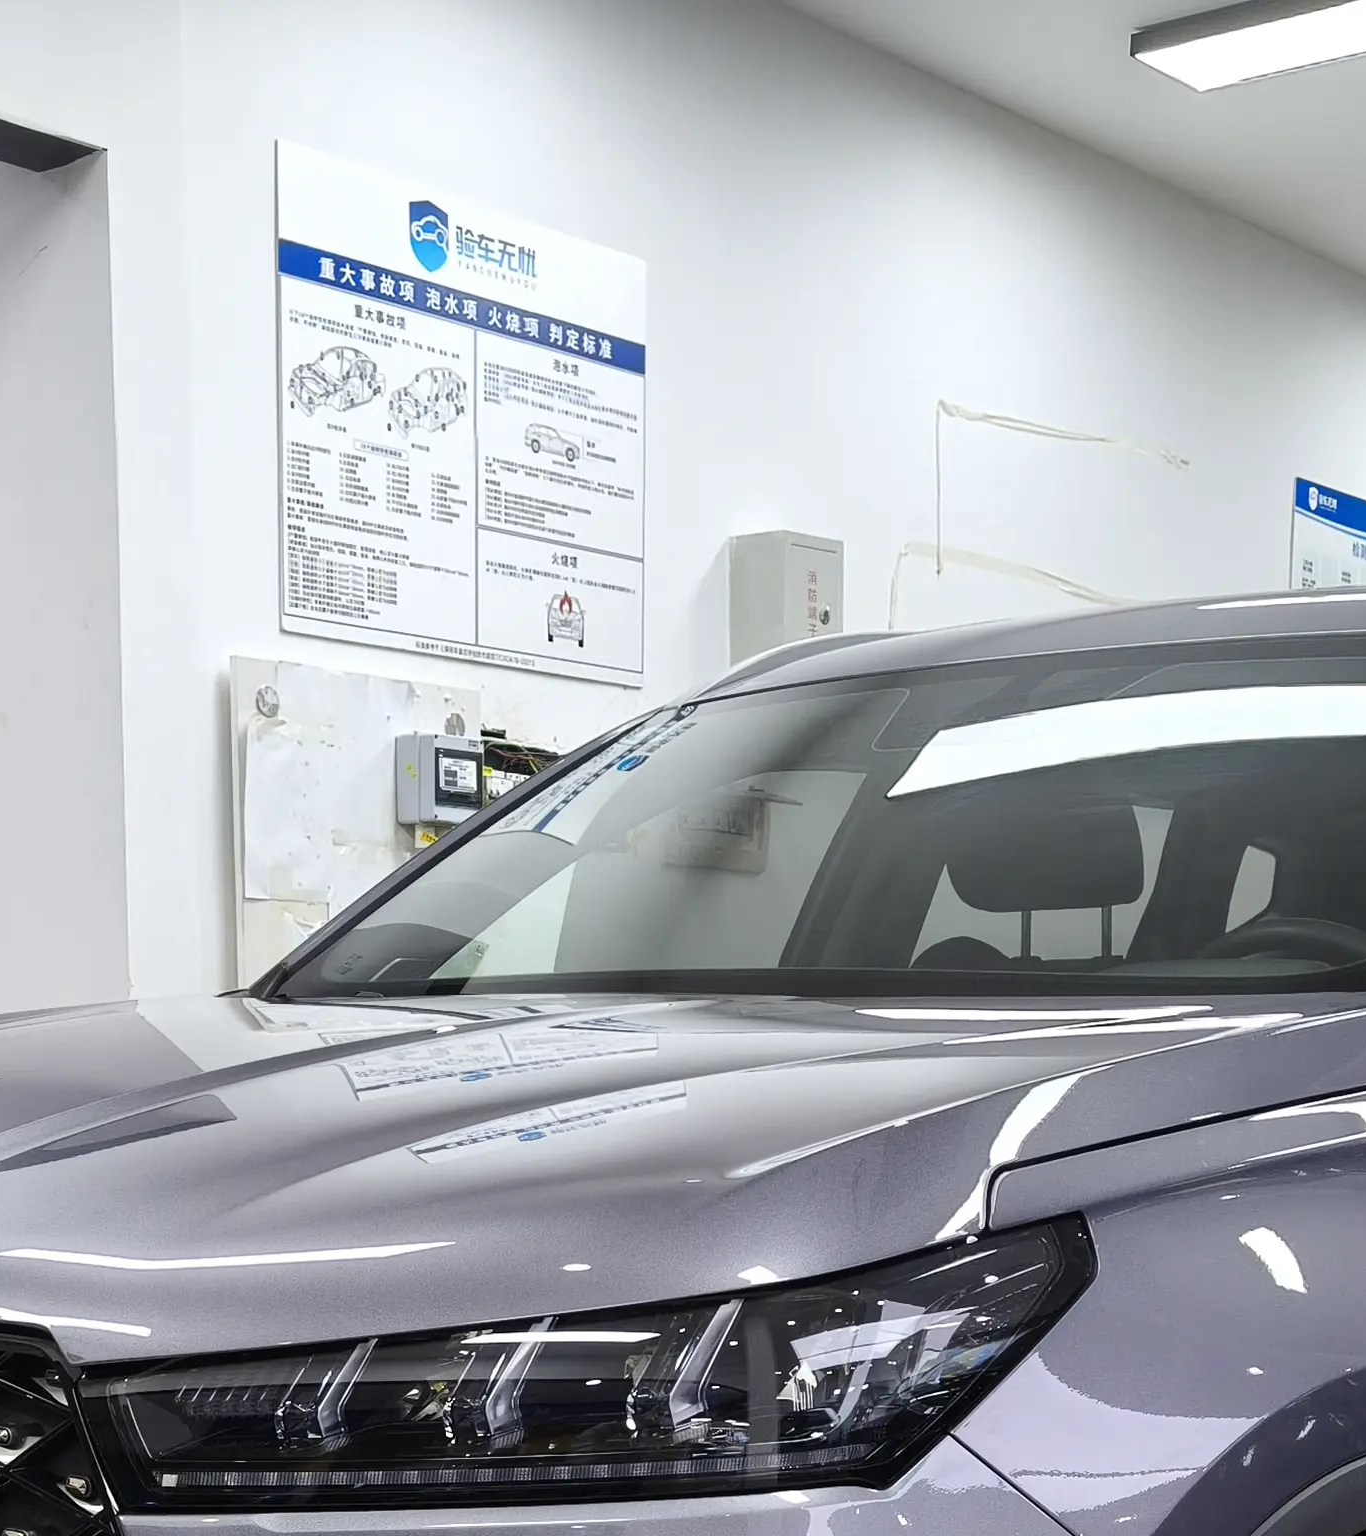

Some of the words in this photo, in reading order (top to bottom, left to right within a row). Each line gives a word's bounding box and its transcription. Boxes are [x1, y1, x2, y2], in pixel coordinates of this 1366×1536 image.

[455, 225, 538, 278] 验车无忧
[318, 257, 415, 303] 重大事故项
[426, 287, 478, 321] 泡水项
[488, 307, 540, 339] 火烧项
[549, 323, 613, 360] 判定标准
[354, 304, 407, 331] 重大事故项
[552, 359, 580, 377] 泡水项
[551, 552, 579, 569] 火烧项
